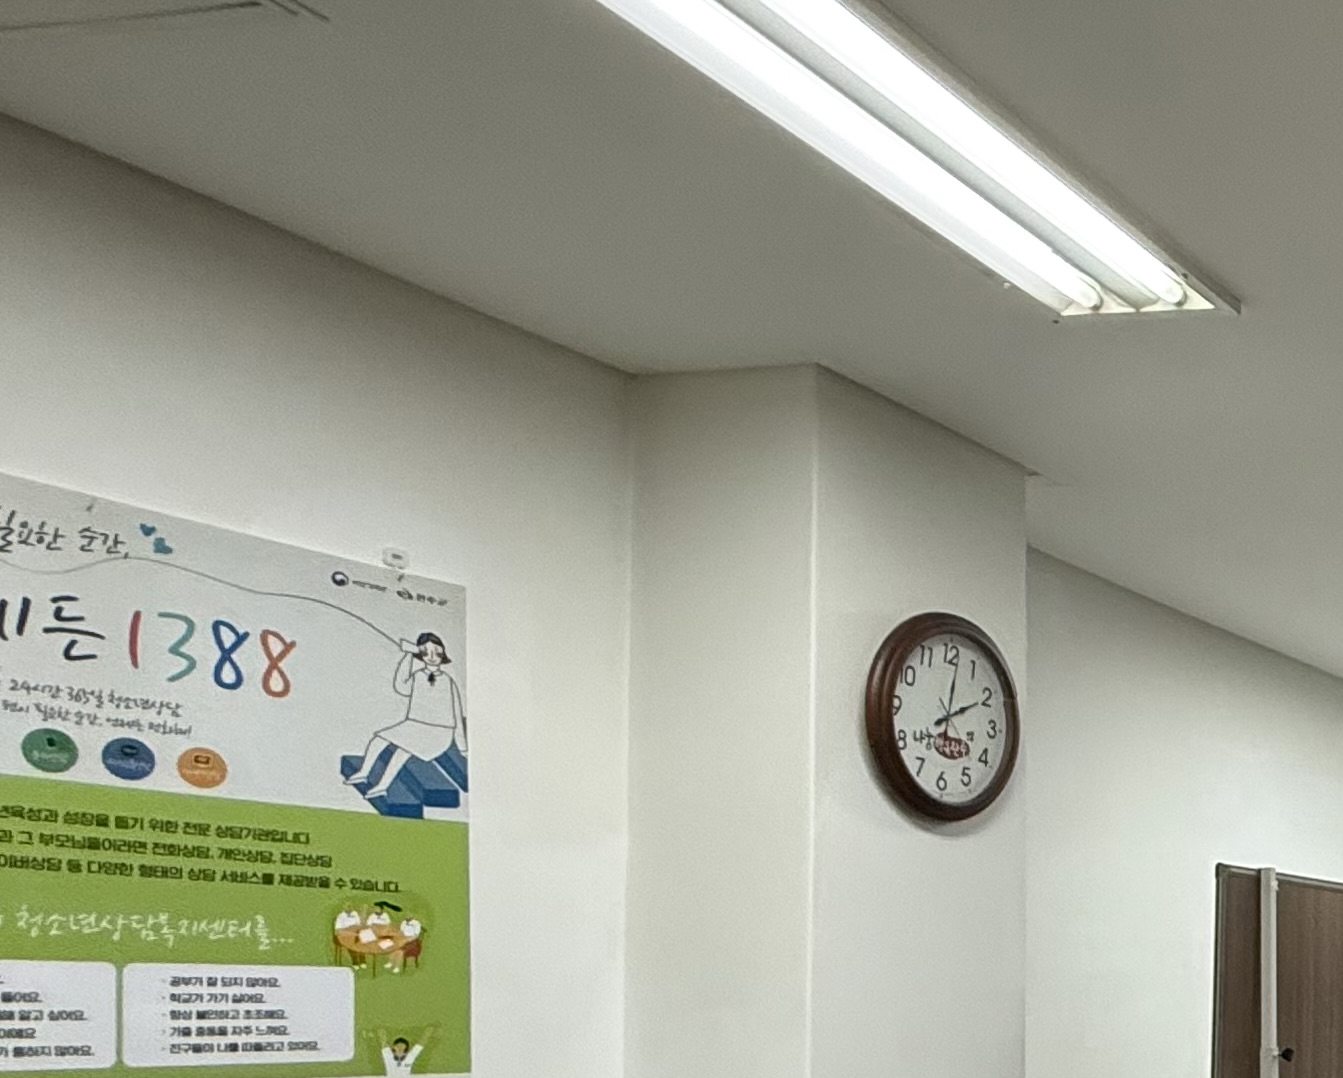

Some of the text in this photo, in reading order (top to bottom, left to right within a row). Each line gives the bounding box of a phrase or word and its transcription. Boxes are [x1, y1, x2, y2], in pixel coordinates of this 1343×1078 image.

[78, 526, 128, 558] 순간,
[128, 609, 297, 698] 1388
[919, 642, 960, 668] 11 12
[970, 660, 978, 681] 1
[981, 687, 993, 708] 2
[897, 728, 908, 751] 8
[987, 719, 998, 740] 3
[915, 757, 926, 777] 7
[978, 747, 989, 768] 4
[936, 767, 972, 791] 6 5
[148, 817, 178, 834] 위한
[182, 821, 212, 837] 전문
[17, 830, 34, 846] 그
[39, 832, 148, 855] 부모님들이라면
[280, 852, 333, 868] 집단상담
[87, 860, 134, 877] 다양한
[187, 867, 216, 882] 상담
[334, 876, 348, 890] 수
